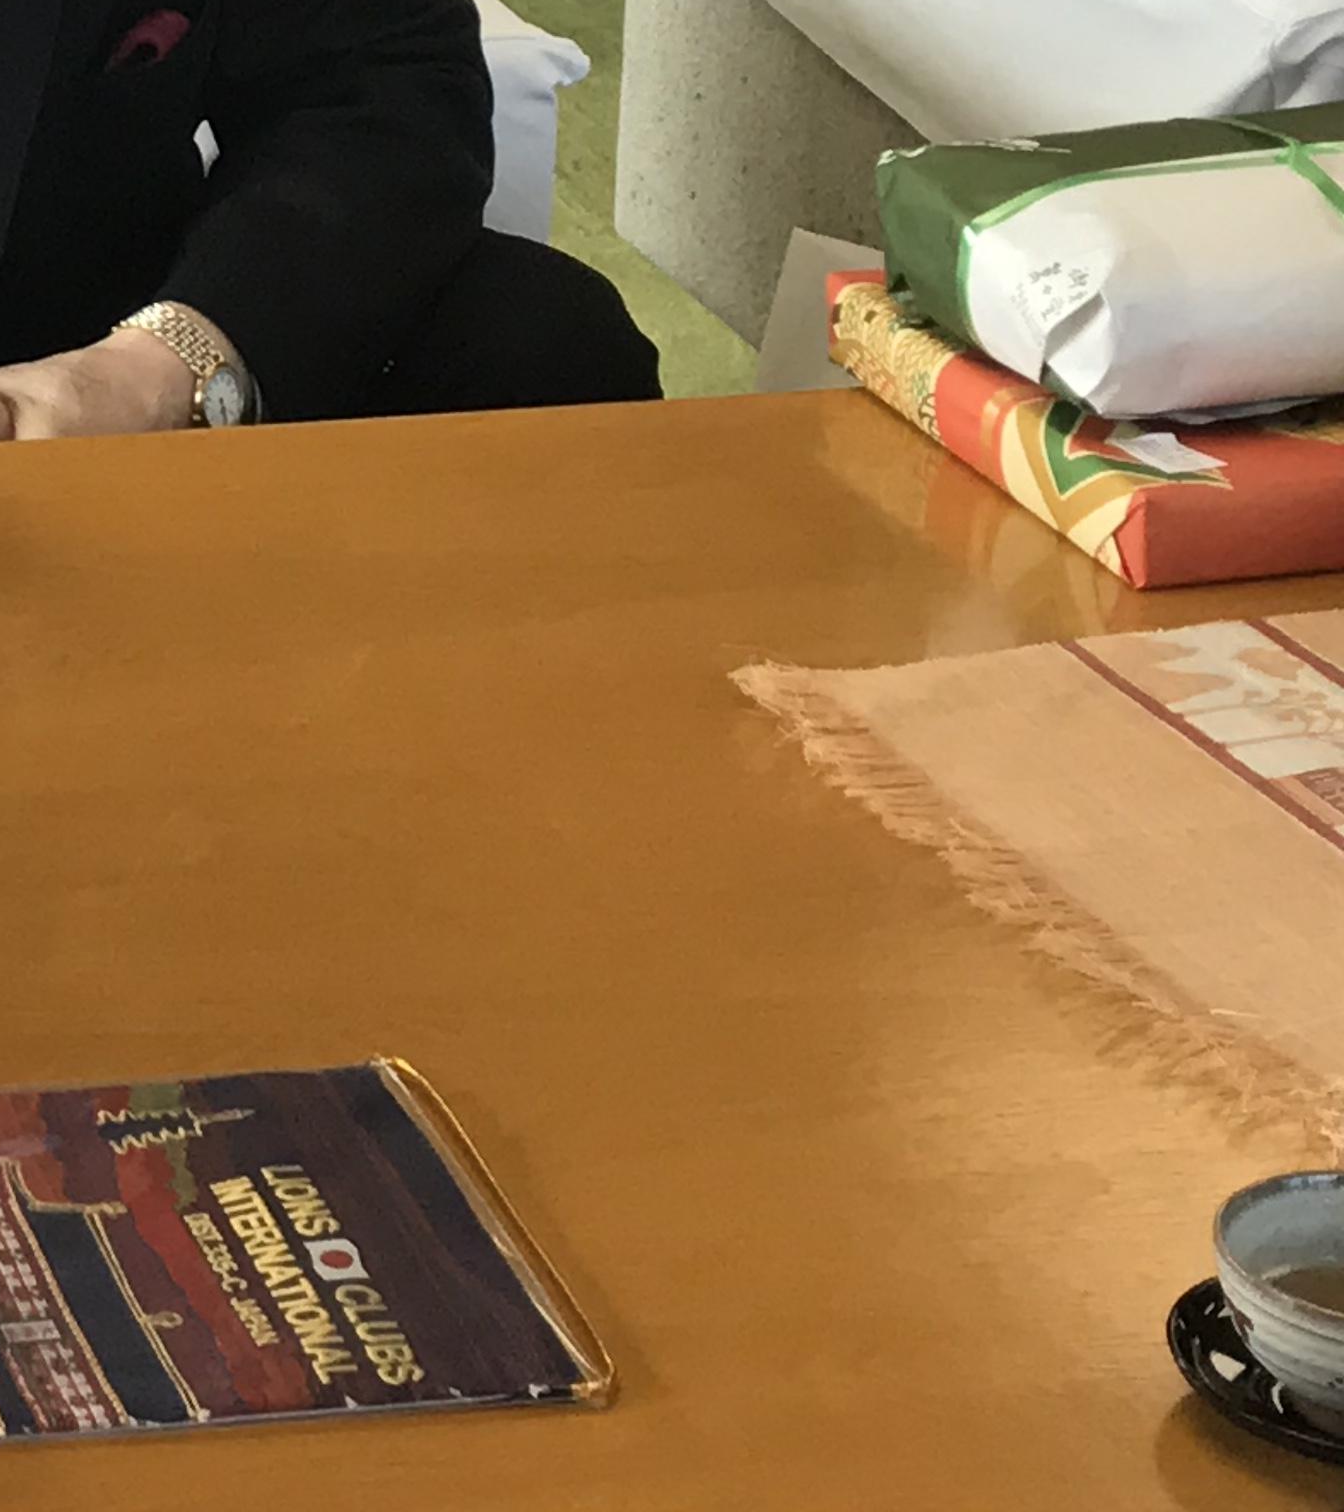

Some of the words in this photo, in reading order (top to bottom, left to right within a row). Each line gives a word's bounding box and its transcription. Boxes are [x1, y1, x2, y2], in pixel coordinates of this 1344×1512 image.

[209, 1175, 359, 1385] INTERNATIONAL
[229, 1296, 280, 1347] JAPAN
[260, 1164, 341, 1237] LIONS
[334, 1284, 426, 1386] CLUBS
